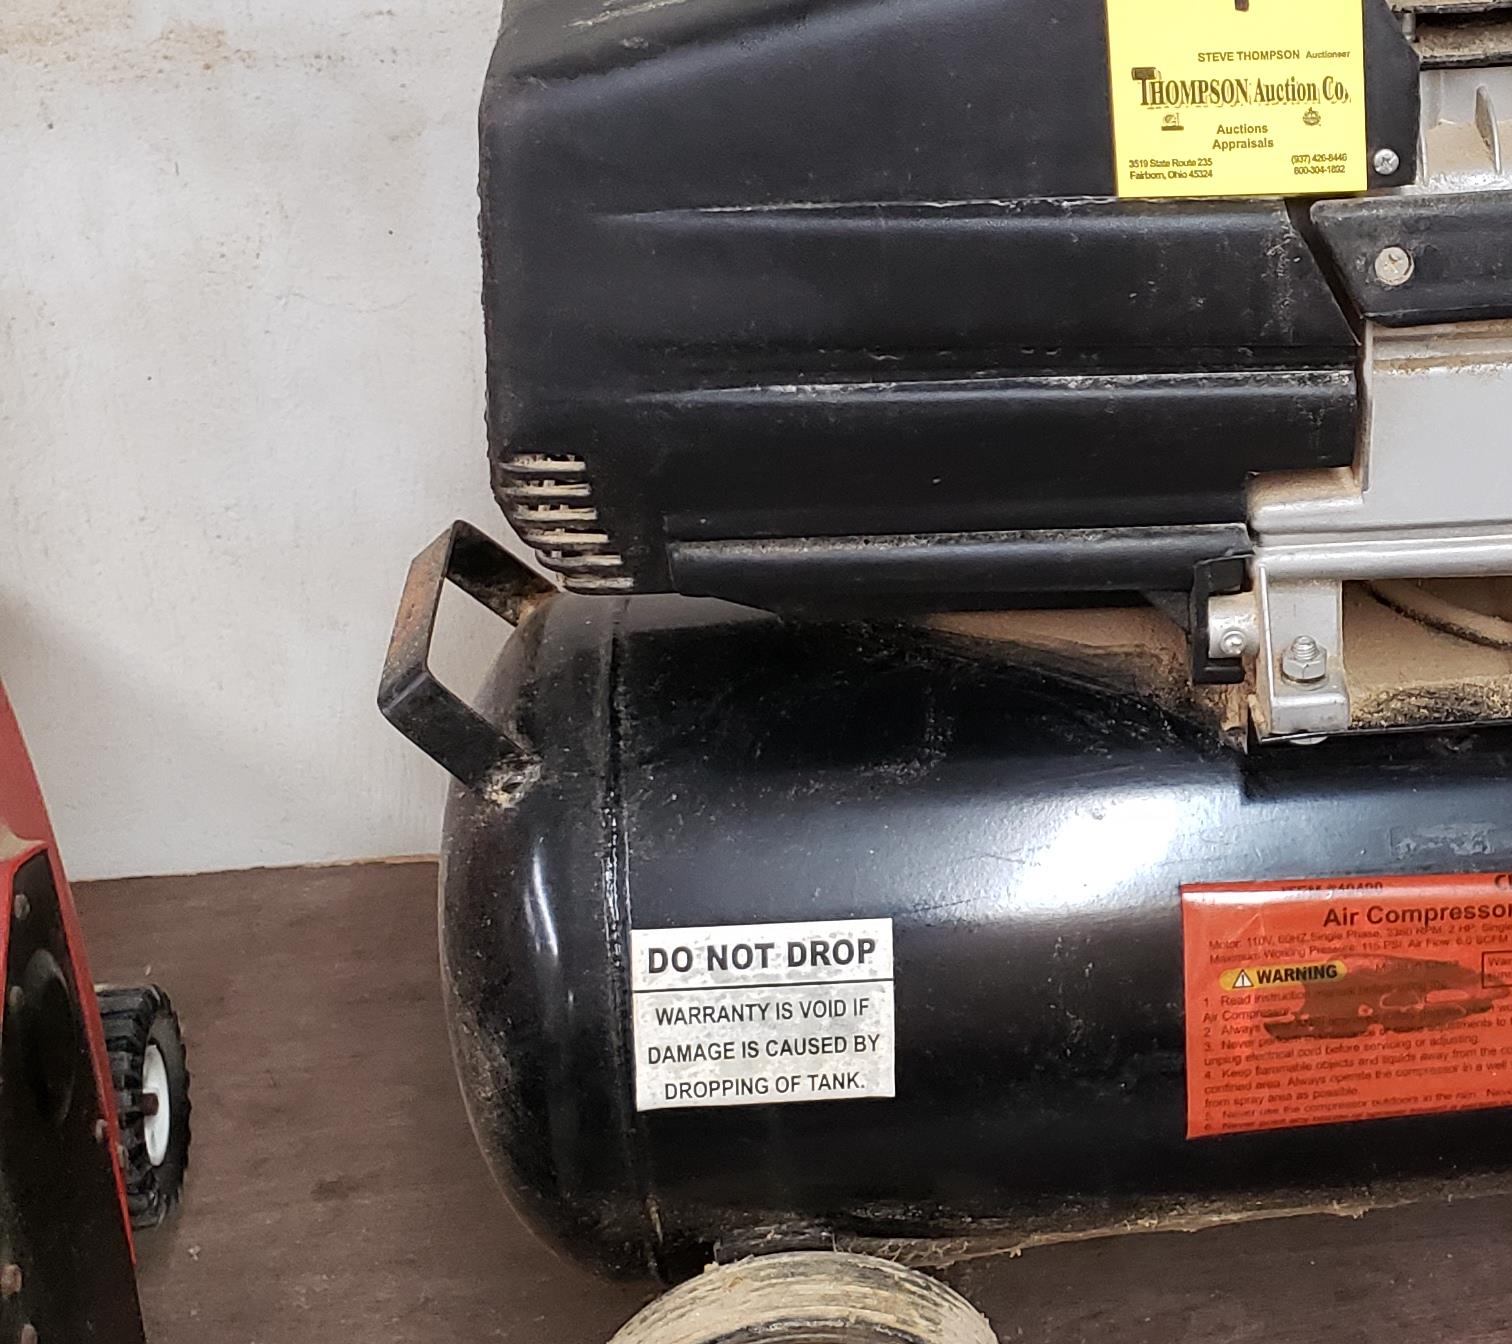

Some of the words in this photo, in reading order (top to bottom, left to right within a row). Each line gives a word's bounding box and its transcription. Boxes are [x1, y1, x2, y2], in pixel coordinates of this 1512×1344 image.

[1197, 51, 1234, 62] STEVE
[1236, 49, 1300, 61] THOMPSON
[1305, 50, 1351, 59] Auctioneer
[1131, 66, 1249, 107] THOMPSON
[1253, 75, 1318, 103] Auction
[1216, 123, 1268, 135] Auctions
[1212, 137, 1274, 152] Appraisals
[1149, 158, 1171, 168] State
[1171, 158, 1197, 167] Route
[1197, 157, 1213, 167] 235
[1167, 169, 1188, 179] Ohio
[1188, 169, 1213, 178] 45324
[1323, 906, 1360, 927] Air
[648, 945, 694, 974] DO
[706, 942, 775, 971] NOT
[787, 937, 876, 968] DROP
[1256, 963, 1338, 984] WARNING
[655, 1002, 771, 1026] WARRANTY
[776, 1001, 793, 1021] IS
[799, 999, 847, 1019] VOID
[853, 997, 870, 1017] IF
[648, 1041, 736, 1065] DAMAGE
[741, 1040, 759, 1059] IS
[765, 1036, 847, 1058] CAUSED
[853, 1034, 881, 1053] BY
[665, 1077, 770, 1101] DROPPING
[775, 1075, 802, 1094] OF
[807, 1071, 866, 1092] TANK.
